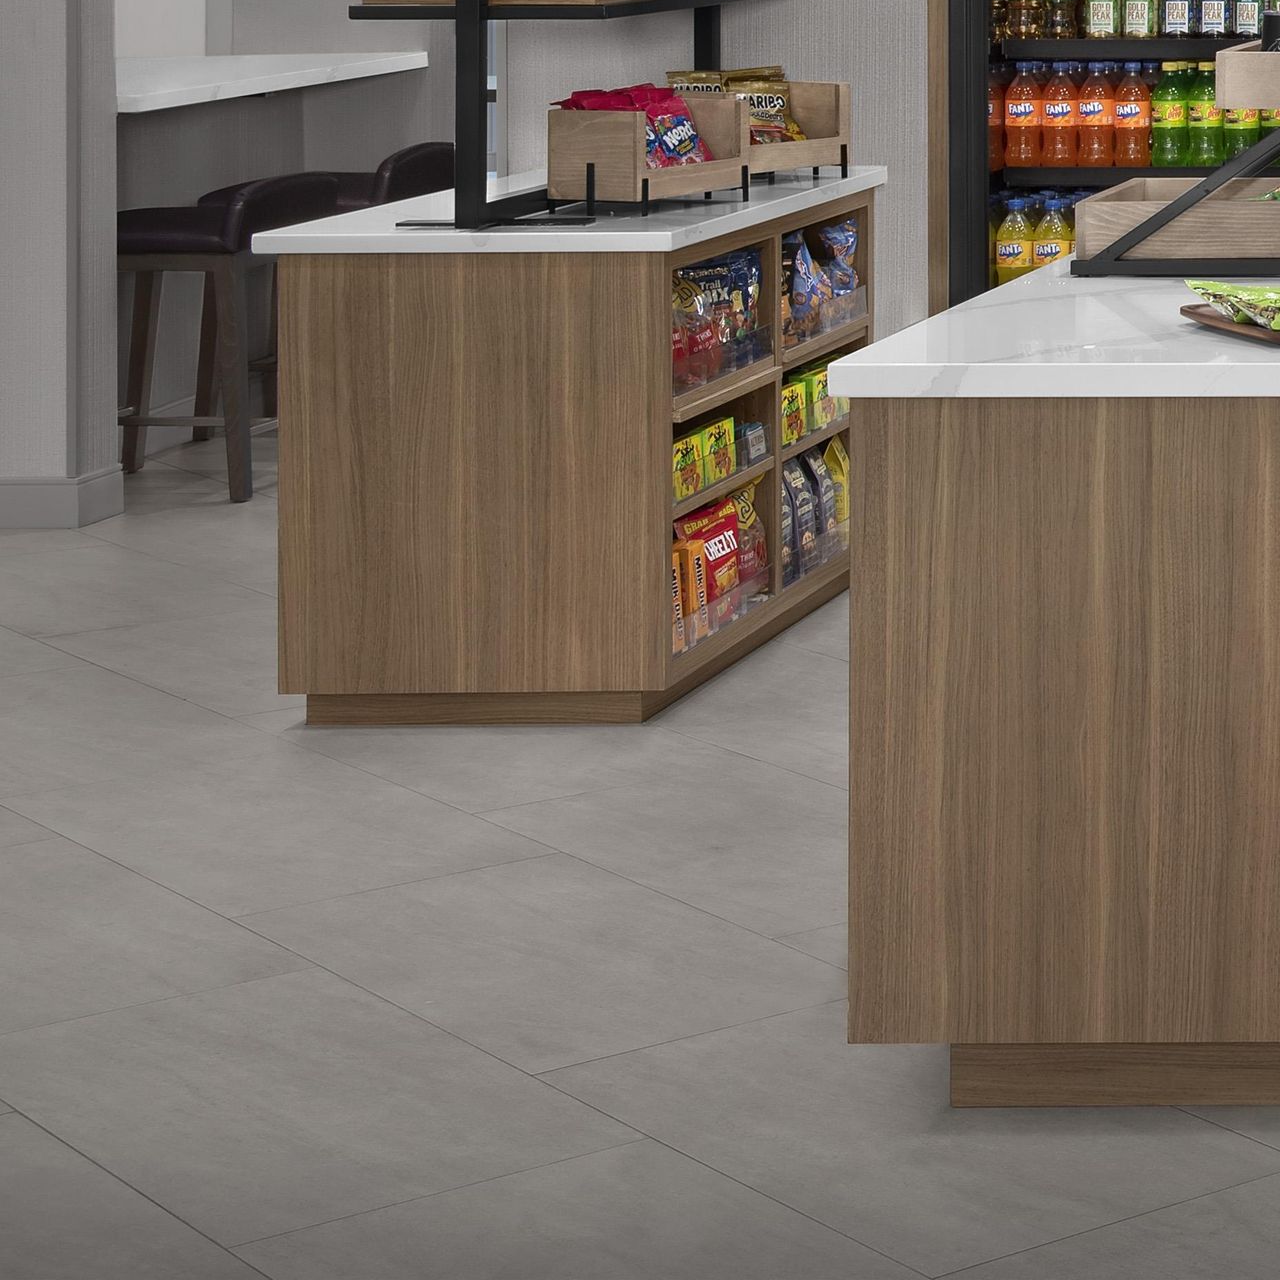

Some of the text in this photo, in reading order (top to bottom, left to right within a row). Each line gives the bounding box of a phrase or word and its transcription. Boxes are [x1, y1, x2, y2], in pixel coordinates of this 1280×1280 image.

[1092, 3, 1110, 12] GOLD
[1128, 3, 1145, 11] GOLD
[1168, 3, 1186, 12] GOLD
[1204, 3, 1222, 12] GOLD
[1238, 4, 1255, 12] GOLD
[1092, 12, 1110, 20] PEAK
[1128, 12, 1145, 20] PEAK
[1168, 12, 1186, 20] PEAK
[1204, 12, 1222, 20] PEAK
[1239, 12, 1254, 20] PEAK
[1009, 102, 1035, 115] FANTA
[1045, 102, 1072, 116] FANTA
[1079, 101, 1104, 114] FANTA
[1116, 103, 1140, 117] FANTA
[997, 243, 1023, 255] FANTA
[1035, 243, 1060, 255] FANTA
